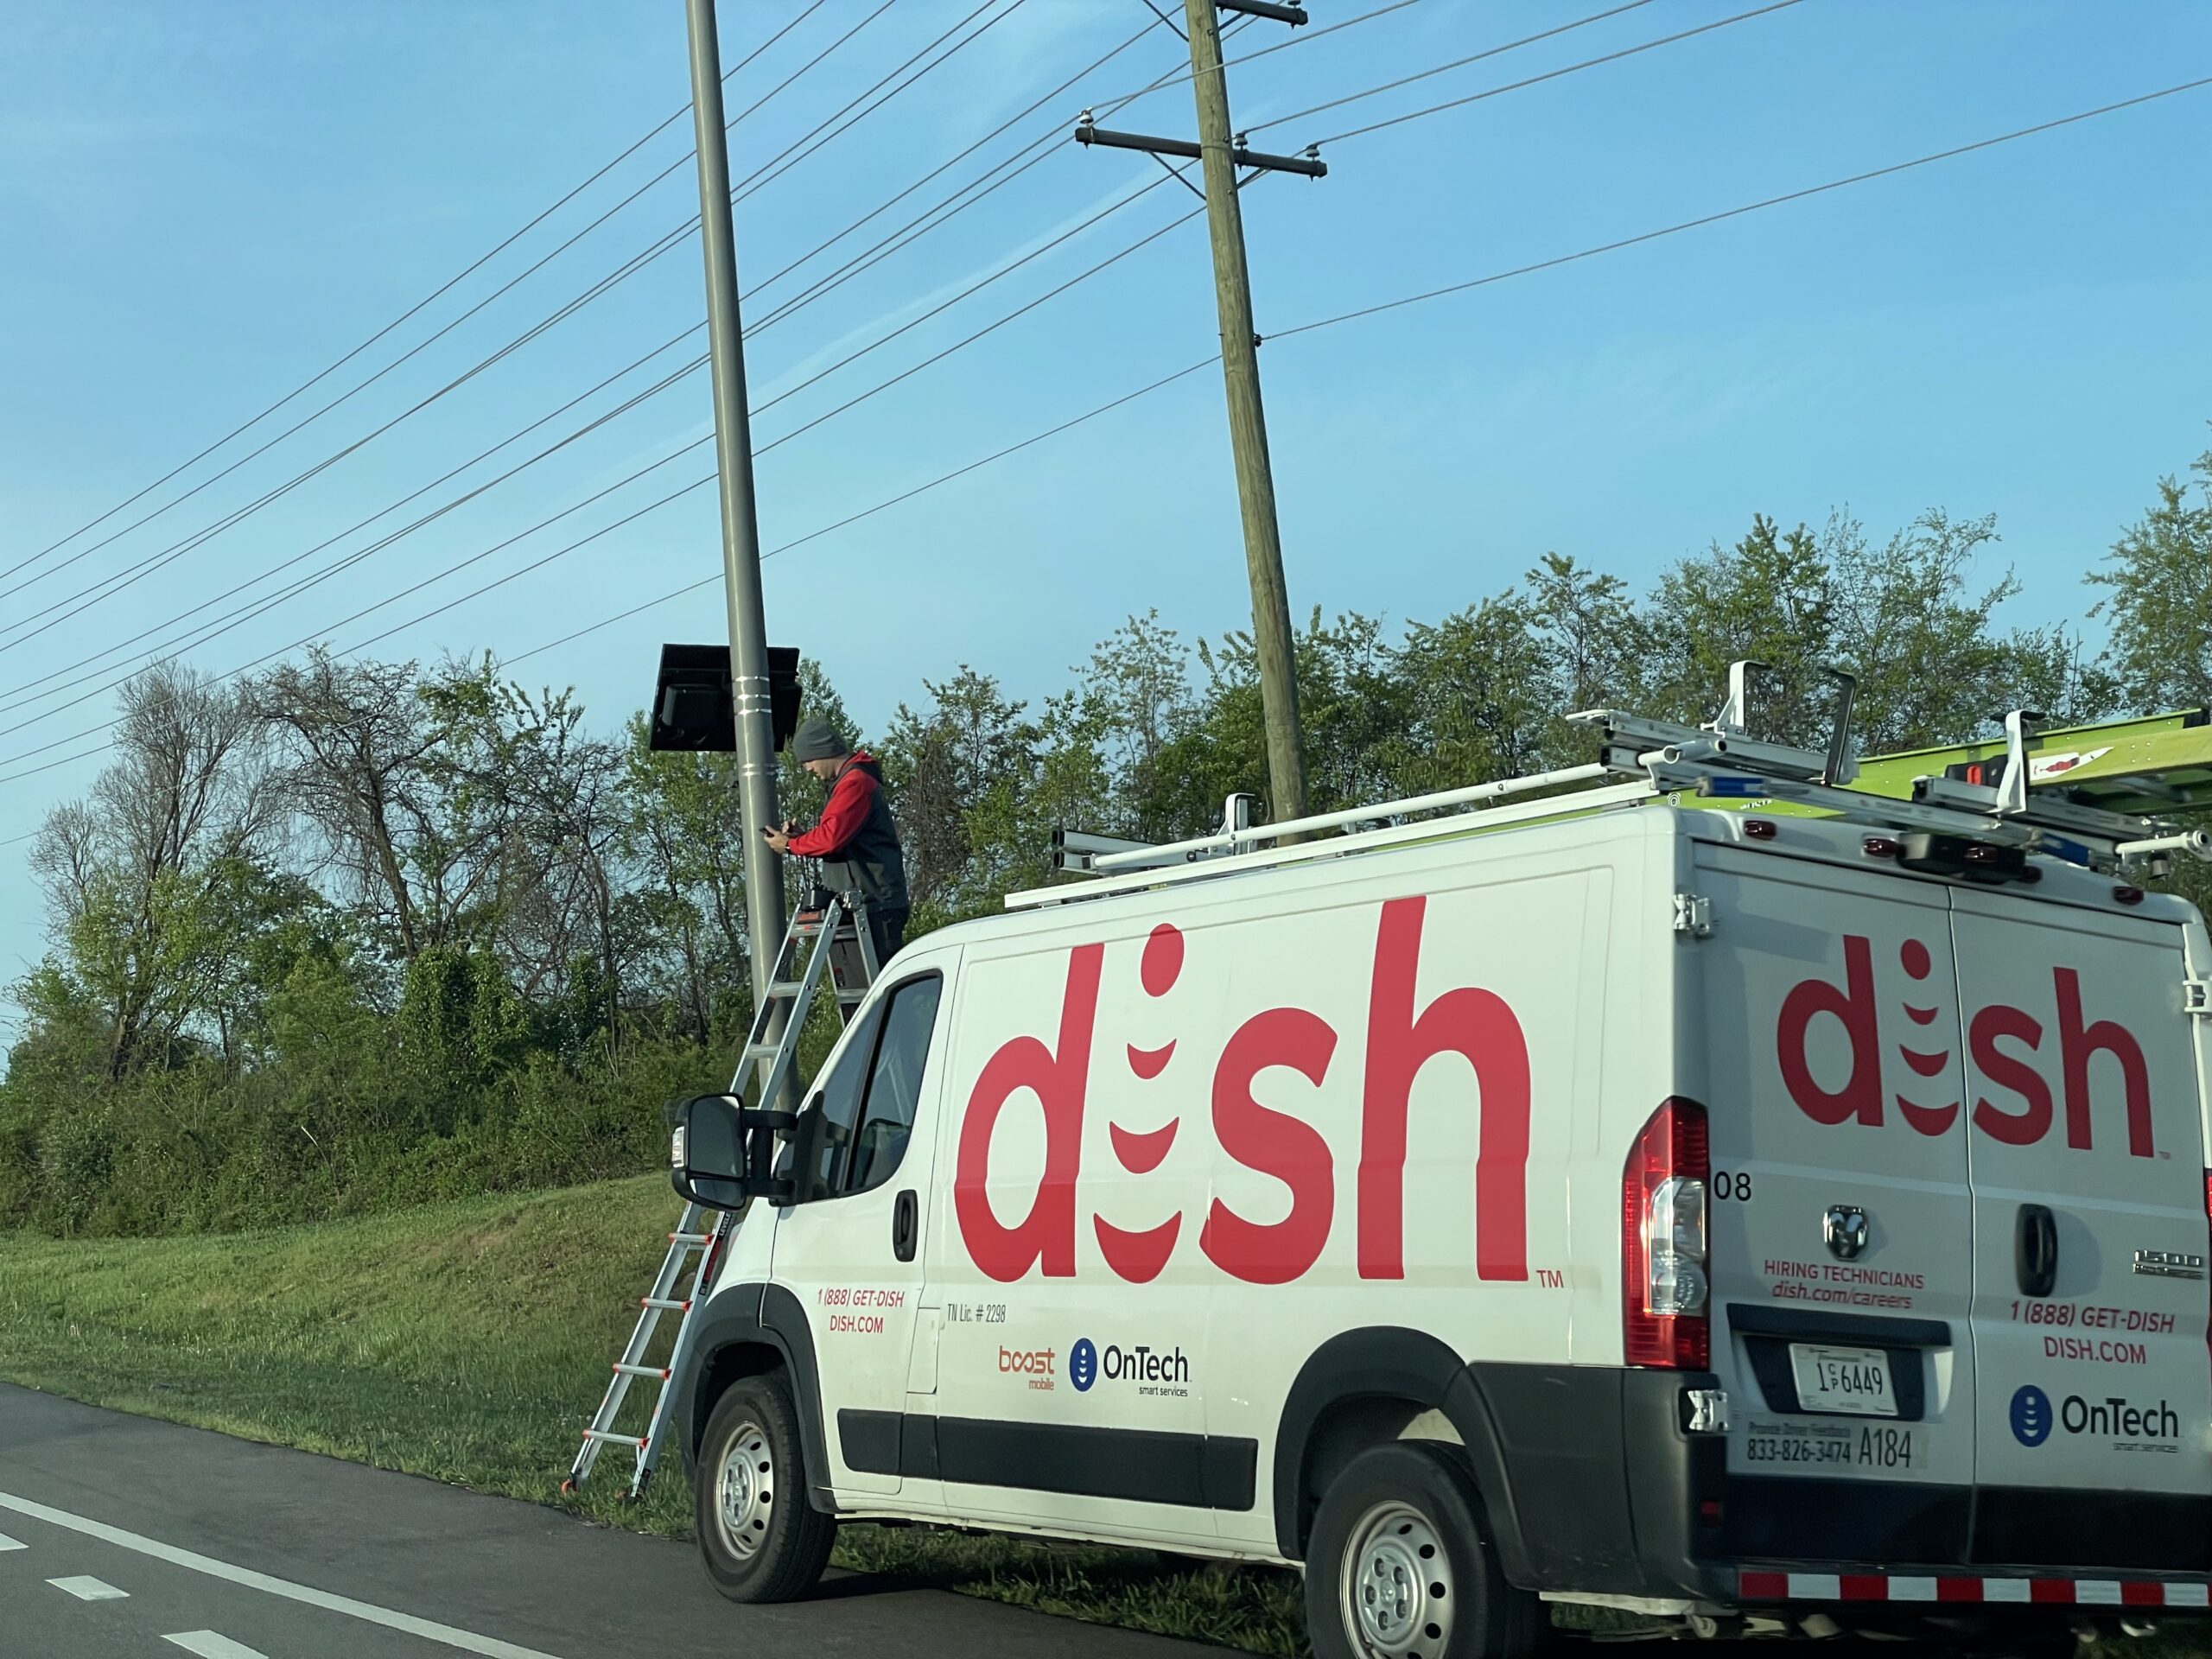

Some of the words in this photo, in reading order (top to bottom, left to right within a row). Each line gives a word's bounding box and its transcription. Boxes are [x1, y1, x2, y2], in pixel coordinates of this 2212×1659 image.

[1777, 934, 2154, 1159] dish
[955, 895, 1531, 1285] dish
[1714, 1171, 1751, 1201] 08
[1764, 1260, 1819, 1280] HIRING
[1822, 1265, 1924, 1289] TECHNICIANS
[817, 1288, 823, 1304] 1
[824, 1287, 851, 1307] (888)
[853, 1289, 906, 1307] GET-DISH
[1772, 1281, 1913, 1309] dish.com/careers
[830, 1314, 884, 1333] DISH.COM
[947, 1303, 957, 1322] TN
[959, 1303, 973, 1322] Lic.
[976, 1303, 984, 1322] #
[985, 1304, 1007, 1323] 2298
[2011, 1300, 2020, 1321] 1
[2024, 1300, 2076, 1327] (888)
[2081, 1306, 2176, 1333] GET-DISH
[999, 1344, 1056, 1375] boost
[1103, 1344, 1188, 1382] OnTech
[2044, 1336, 2147, 1364] DISH.COM
[1028, 1377, 1055, 1391] mobile
[1139, 1386, 1159, 1395] smart
[1160, 1386, 1188, 1397] services
[2061, 1395, 2179, 1438] OnTech
[1747, 1438, 1852, 1464] 833-826-3474
[1859, 1427, 1912, 1468] A184
